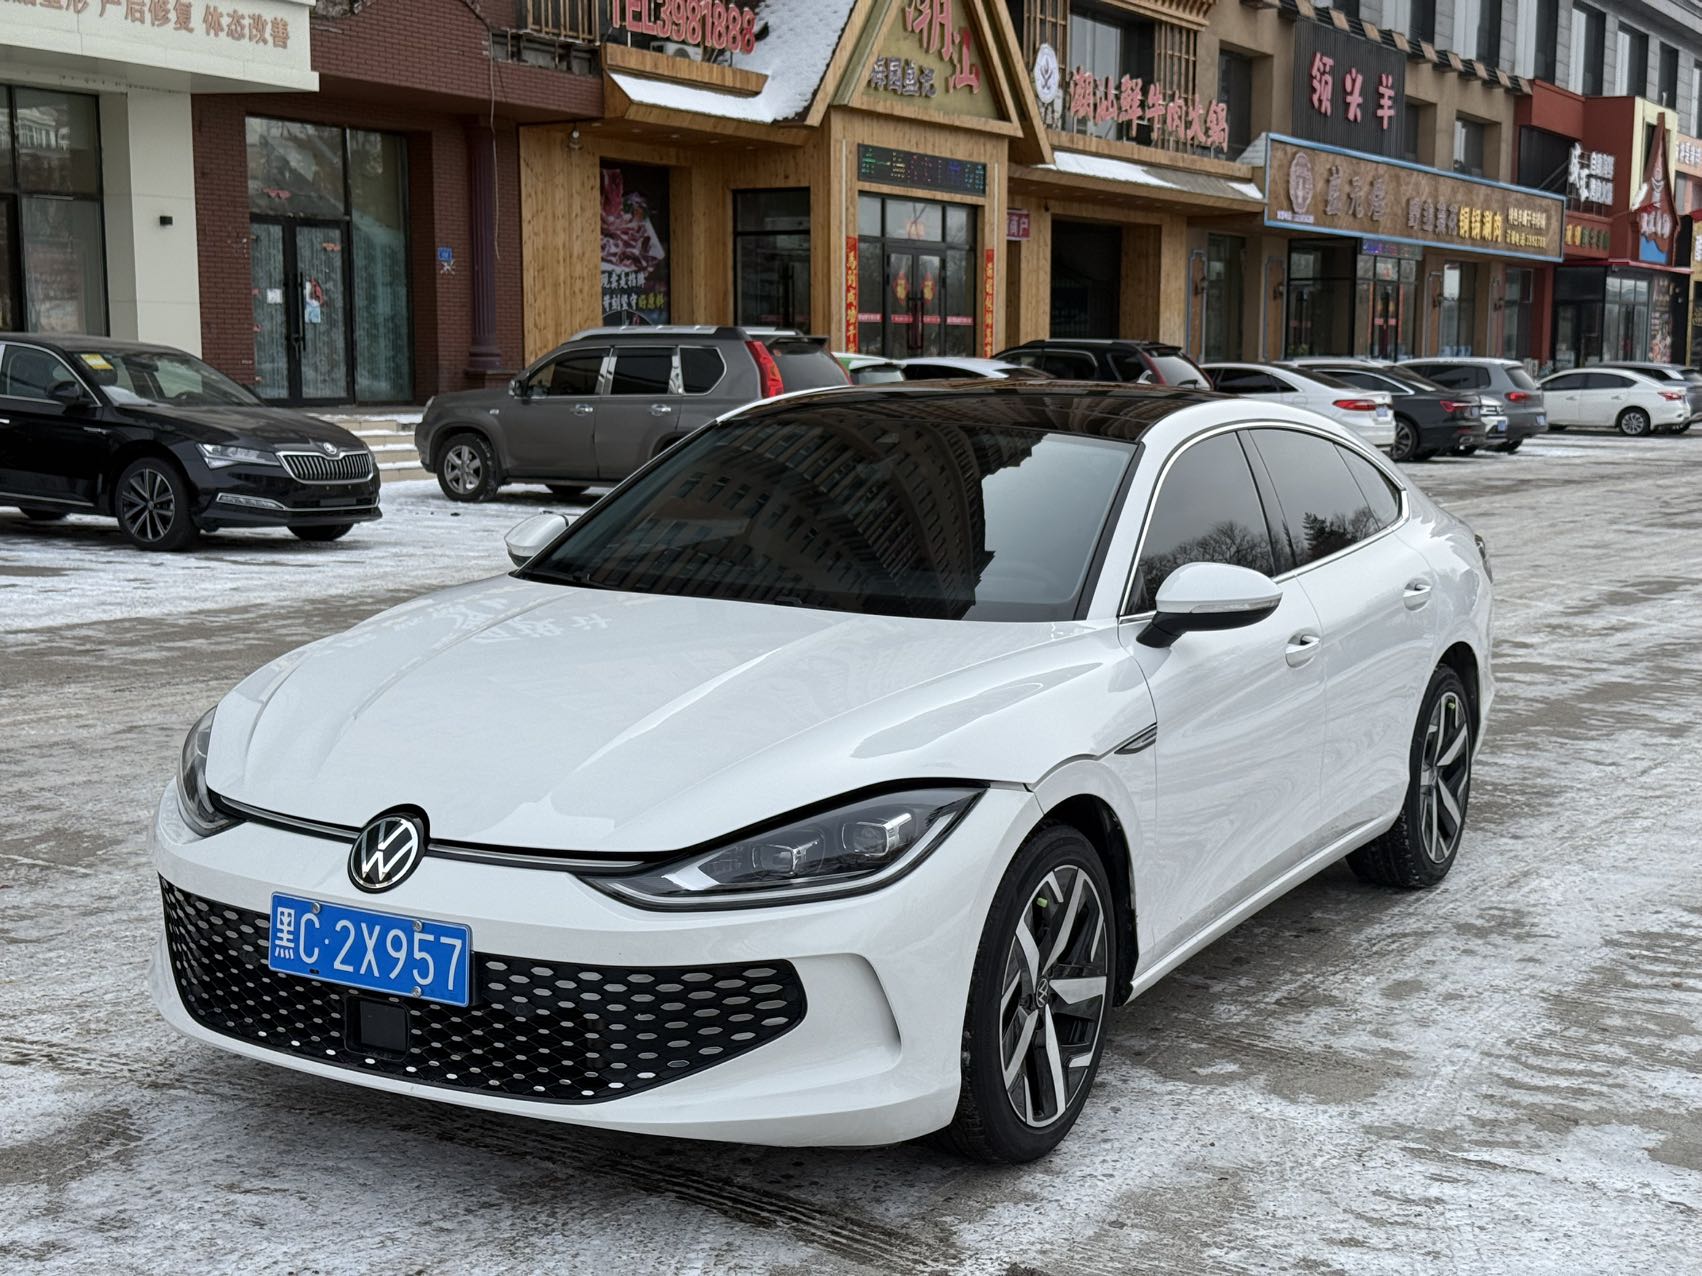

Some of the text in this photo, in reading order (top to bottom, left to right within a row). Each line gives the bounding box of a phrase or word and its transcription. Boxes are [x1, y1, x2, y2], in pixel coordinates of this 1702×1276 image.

[202, 4, 290, 49] 体态改善
[1069, 65, 1230, 153] 潮汕鲜牛肉火锅
[1309, 51, 1396, 130] 领头羊
[1008, 214, 1030, 239] 商户
